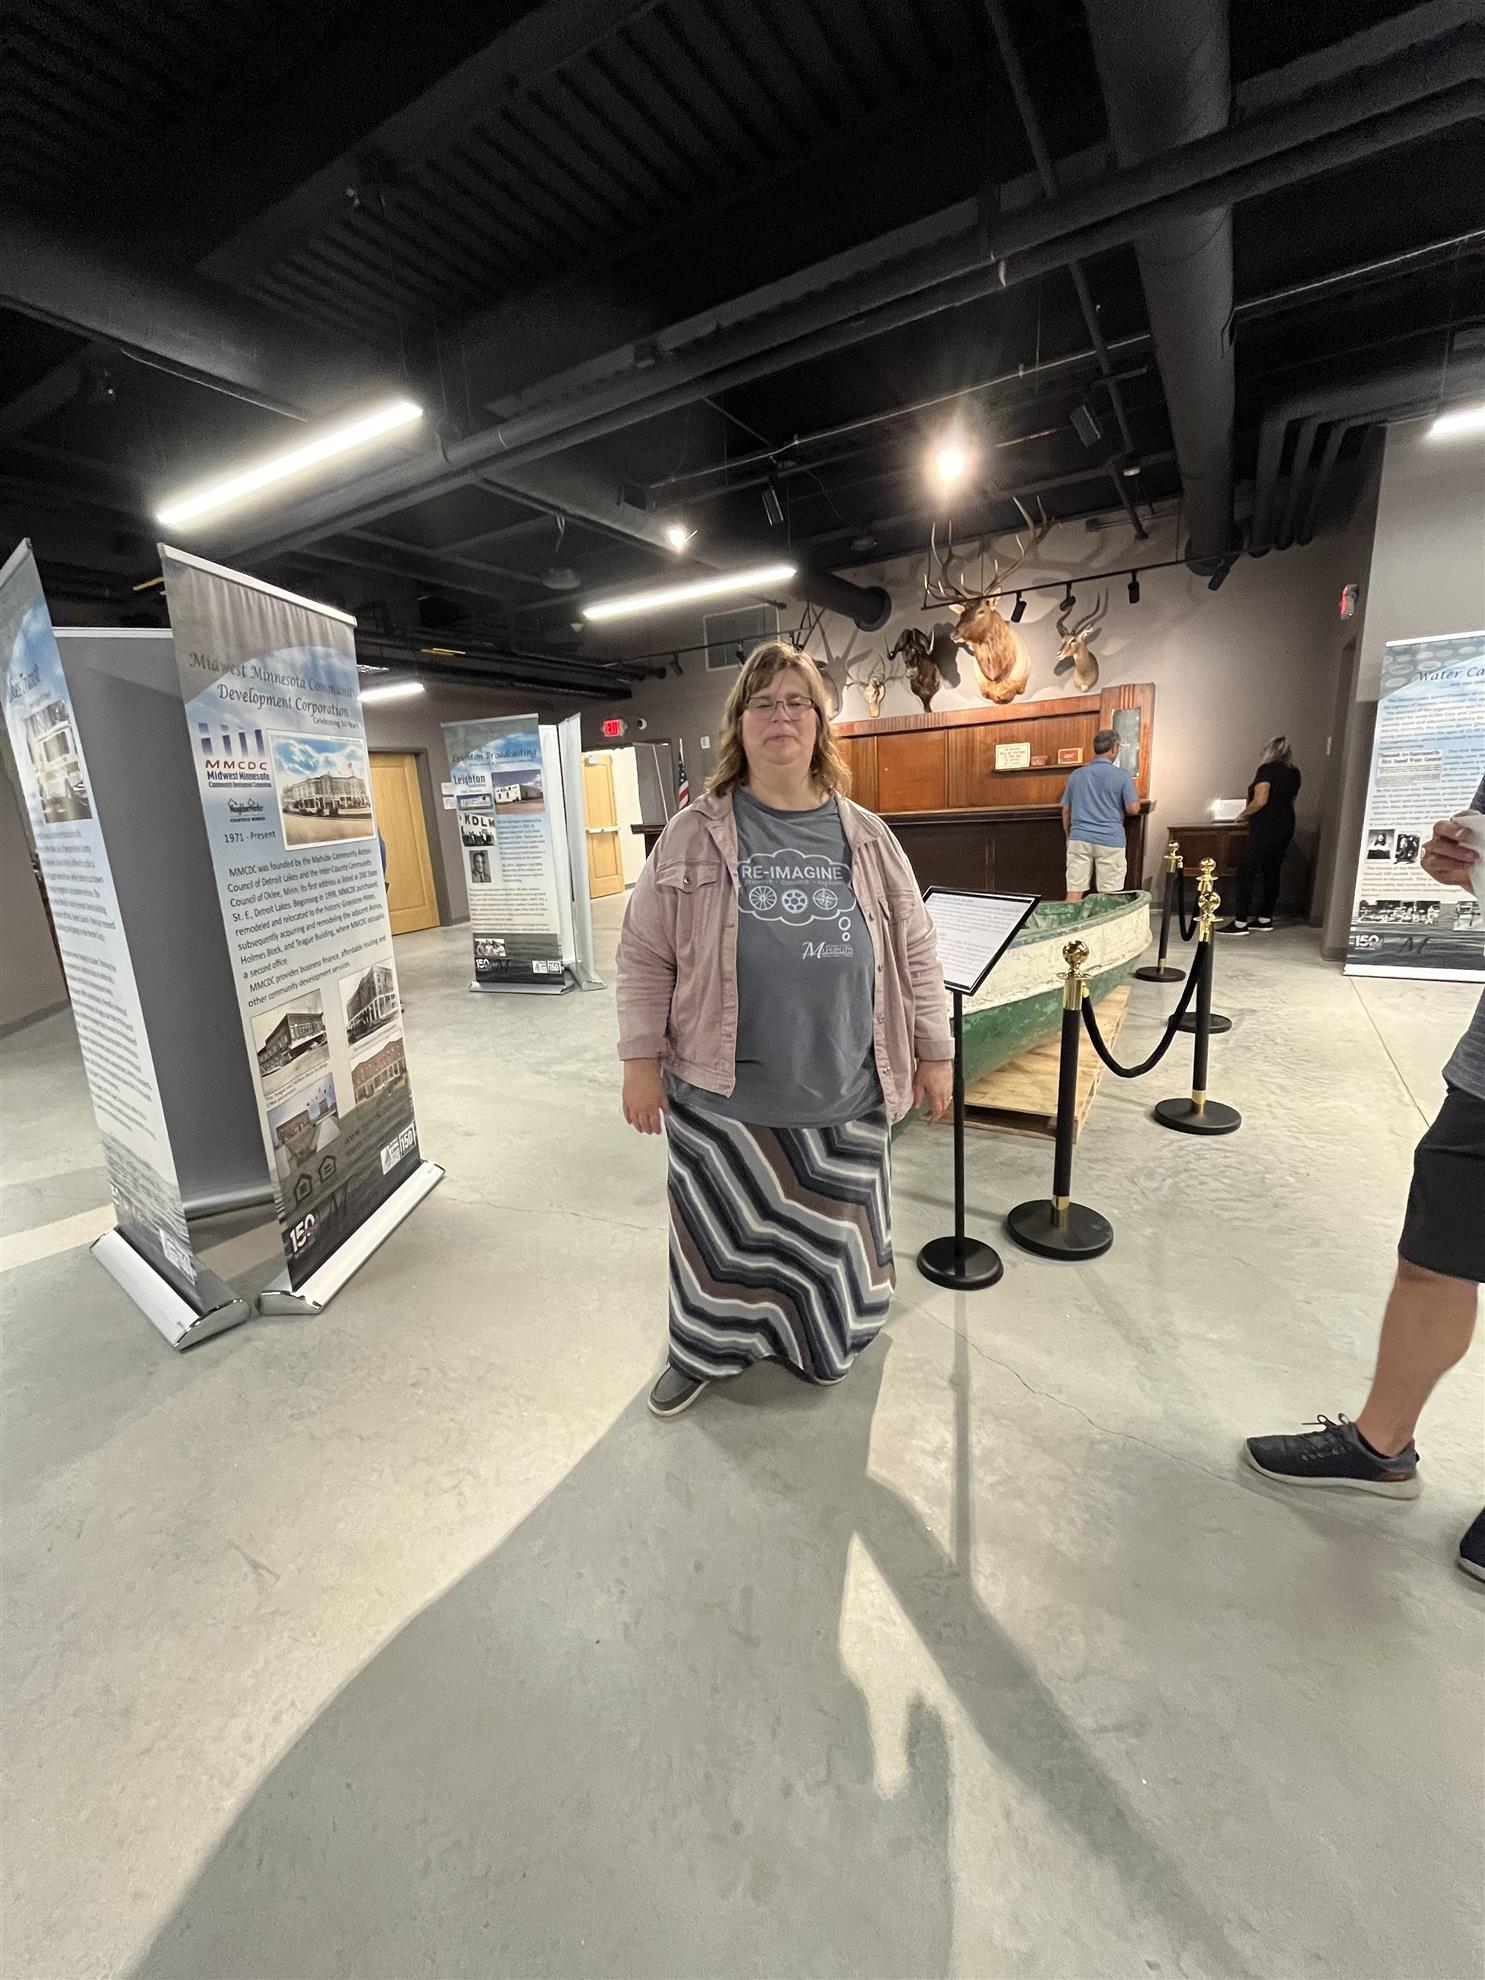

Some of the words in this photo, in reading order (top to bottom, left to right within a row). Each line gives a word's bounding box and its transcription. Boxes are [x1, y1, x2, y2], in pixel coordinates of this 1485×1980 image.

[189, 652, 246, 679] Midwest
[251, 665, 306, 689] Minnesota
[1418, 670, 1462, 681] Water
[217, 683, 292, 711] Development
[295, 697, 349, 718] Corporation
[486, 748, 537, 760] Broadcasting
[205, 759, 268, 771] MMCDC
[207, 770, 239, 781] Midwest
[239, 771, 270, 781] Minnesota
[453, 774, 486, 785] Leighton
[464, 814, 495, 827] KDLM
[225, 833, 245, 843] 1971
[250, 831, 276, 840] Present
[229, 865, 257, 877] MMCDC
[258, 864, 269, 873] was
[270, 860, 294, 870] founded
[294, 858, 302, 867] by
[302, 857, 311, 866] the
[741, 865, 843, 880] RE-IMAGINE
[227, 881, 253, 893] Council
[254, 877, 261, 888] of
[261, 875, 282, 887] Detroit
[283, 873, 299, 882] Lakes
[299, 871, 310, 880] and
[230, 894, 256, 907] Council
[257, 893, 263, 902] of
[232, 913, 243, 922] St.
[254, 905, 274, 917] Detroit
[235, 921, 270, 936] remodeled
[271, 917, 282, 928] and
[283, 909, 309, 924] relocated
[237, 932, 279, 951] subsequently
[280, 926, 305, 939] acquiring
[306, 922, 316, 931] and
[1355, 934, 1380, 947] 150
[240, 952, 266, 965] Holmes
[284, 941, 295, 951] and
[801, 941, 854, 960] Museum
[250, 962, 272, 977] second
[476, 959, 490, 969] 150
[248, 995, 267, 1008] other
[268, 983, 298, 1000] community
[299, 968, 332, 987] development
[249, 976, 275, 993] MMCDC
[275, 968, 300, 984] provides
[402, 1130, 413, 1151] 150
[289, 1213, 316, 1253] 150
